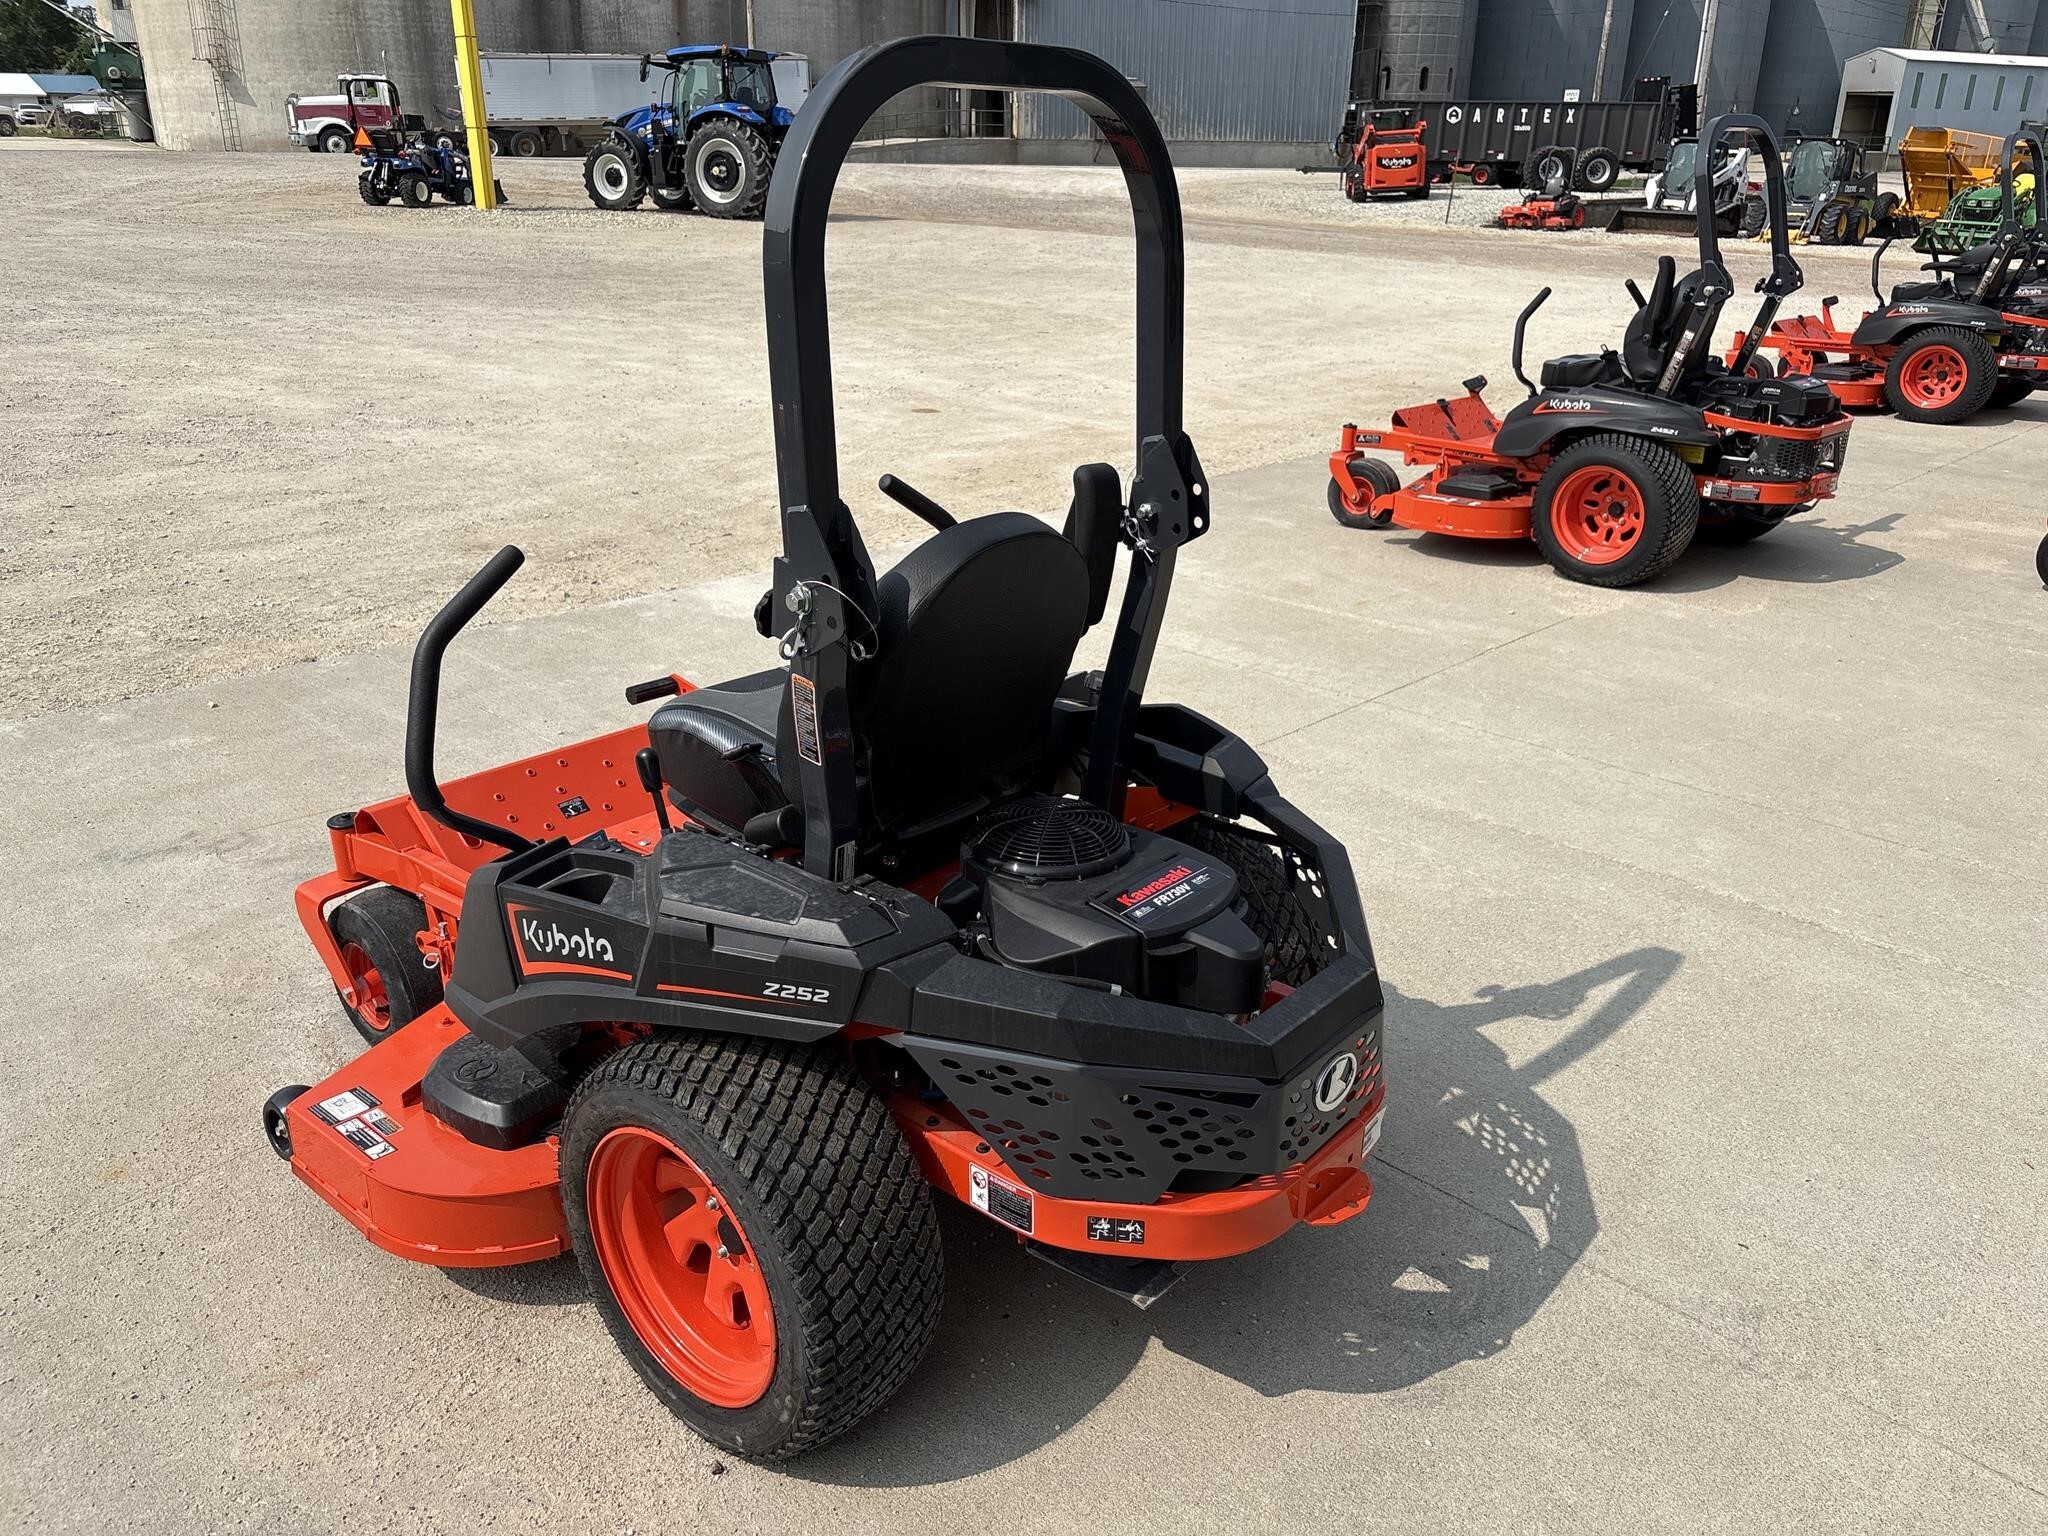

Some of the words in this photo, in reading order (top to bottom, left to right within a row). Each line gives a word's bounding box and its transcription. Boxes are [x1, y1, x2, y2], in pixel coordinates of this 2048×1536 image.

[1472, 107, 1576, 124] ARTEX
[1381, 157, 1412, 167] Kubota
[1899, 305, 1929, 313] Kubota
[1549, 399, 1591, 410] Kubota
[1116, 865, 1193, 907] Kawasaki
[1152, 882, 1191, 906] FR730V
[521, 917, 615, 962] Kubota
[762, 981, 831, 1004] Z252
